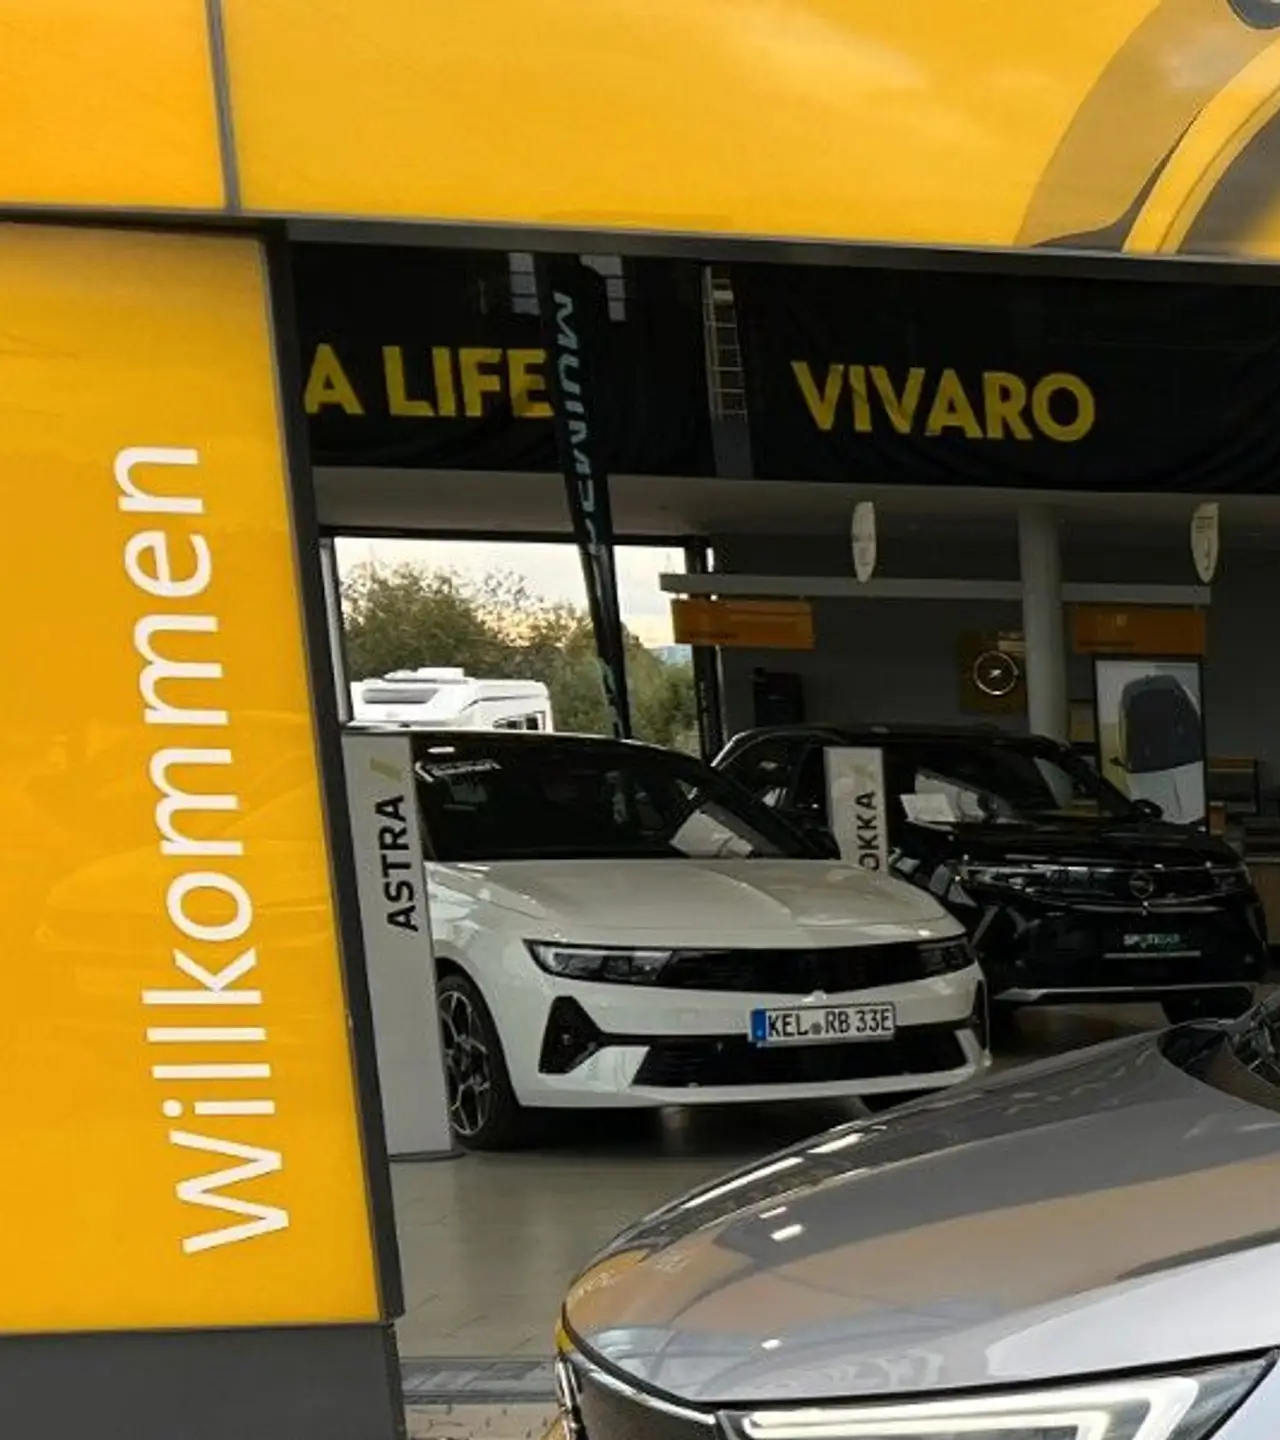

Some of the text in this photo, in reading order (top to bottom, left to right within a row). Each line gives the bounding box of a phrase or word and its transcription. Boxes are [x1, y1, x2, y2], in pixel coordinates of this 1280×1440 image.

[382, 345, 555, 418] LIFE
[790, 361, 1096, 442] VIVARO
[113, 446, 290, 1254] Willkommen
[374, 794, 419, 933] ASTRA
[855, 790, 880, 871] OKKA
[767, 1007, 893, 1038] KEL RB 33E
